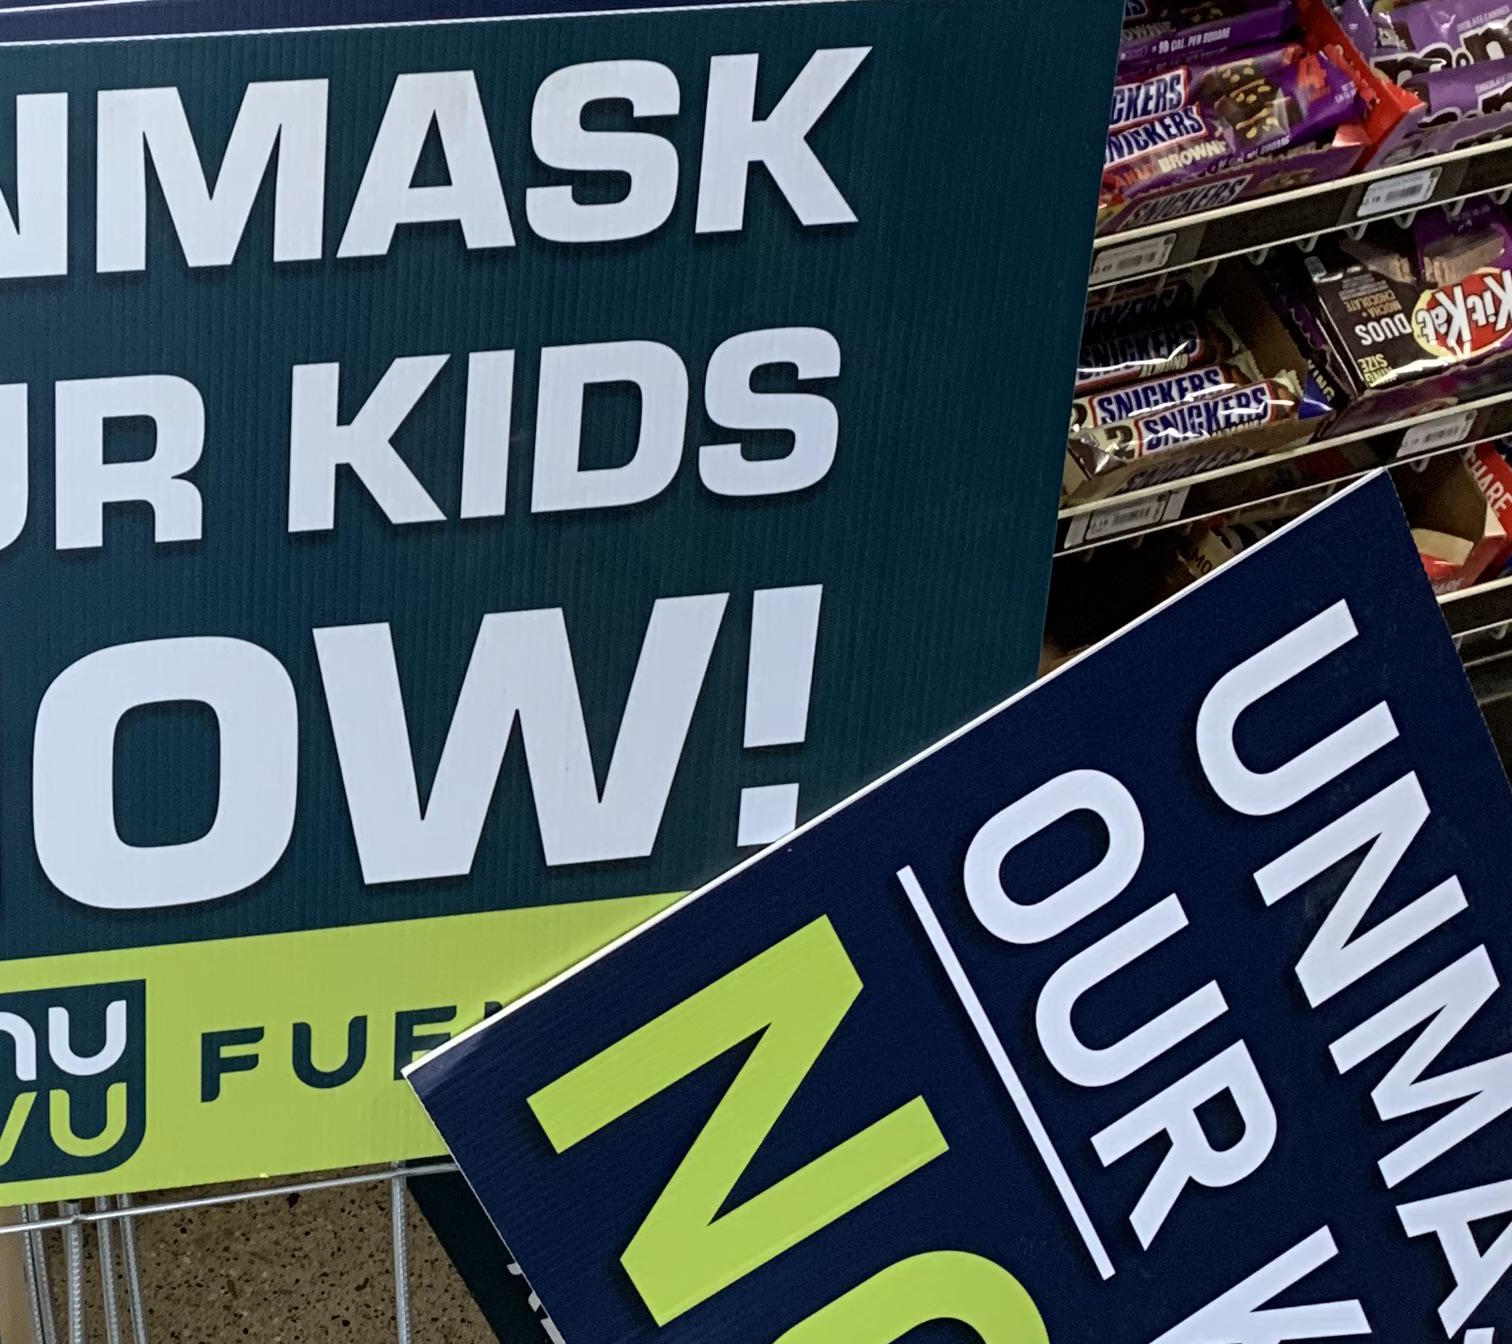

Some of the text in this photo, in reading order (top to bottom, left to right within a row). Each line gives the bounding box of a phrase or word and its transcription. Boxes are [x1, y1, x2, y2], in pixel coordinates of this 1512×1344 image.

[1112, 73, 1184, 126] CKERS
[1106, 104, 1204, 163] NICKERS
[1345, 289, 1397, 312] CHOCOLATE
[1368, 299, 1402, 318] MOCHA
[1354, 312, 1413, 346] DUOS
[1357, 354, 1389, 374] SIZE
[1096, 370, 1222, 426] SNICKERS
[1144, 386, 1270, 453] SNICKERS
[288, 326, 841, 534] KIDS
[962, 767, 1278, 1251] OUR
[200, 1001, 503, 1103] FUE
